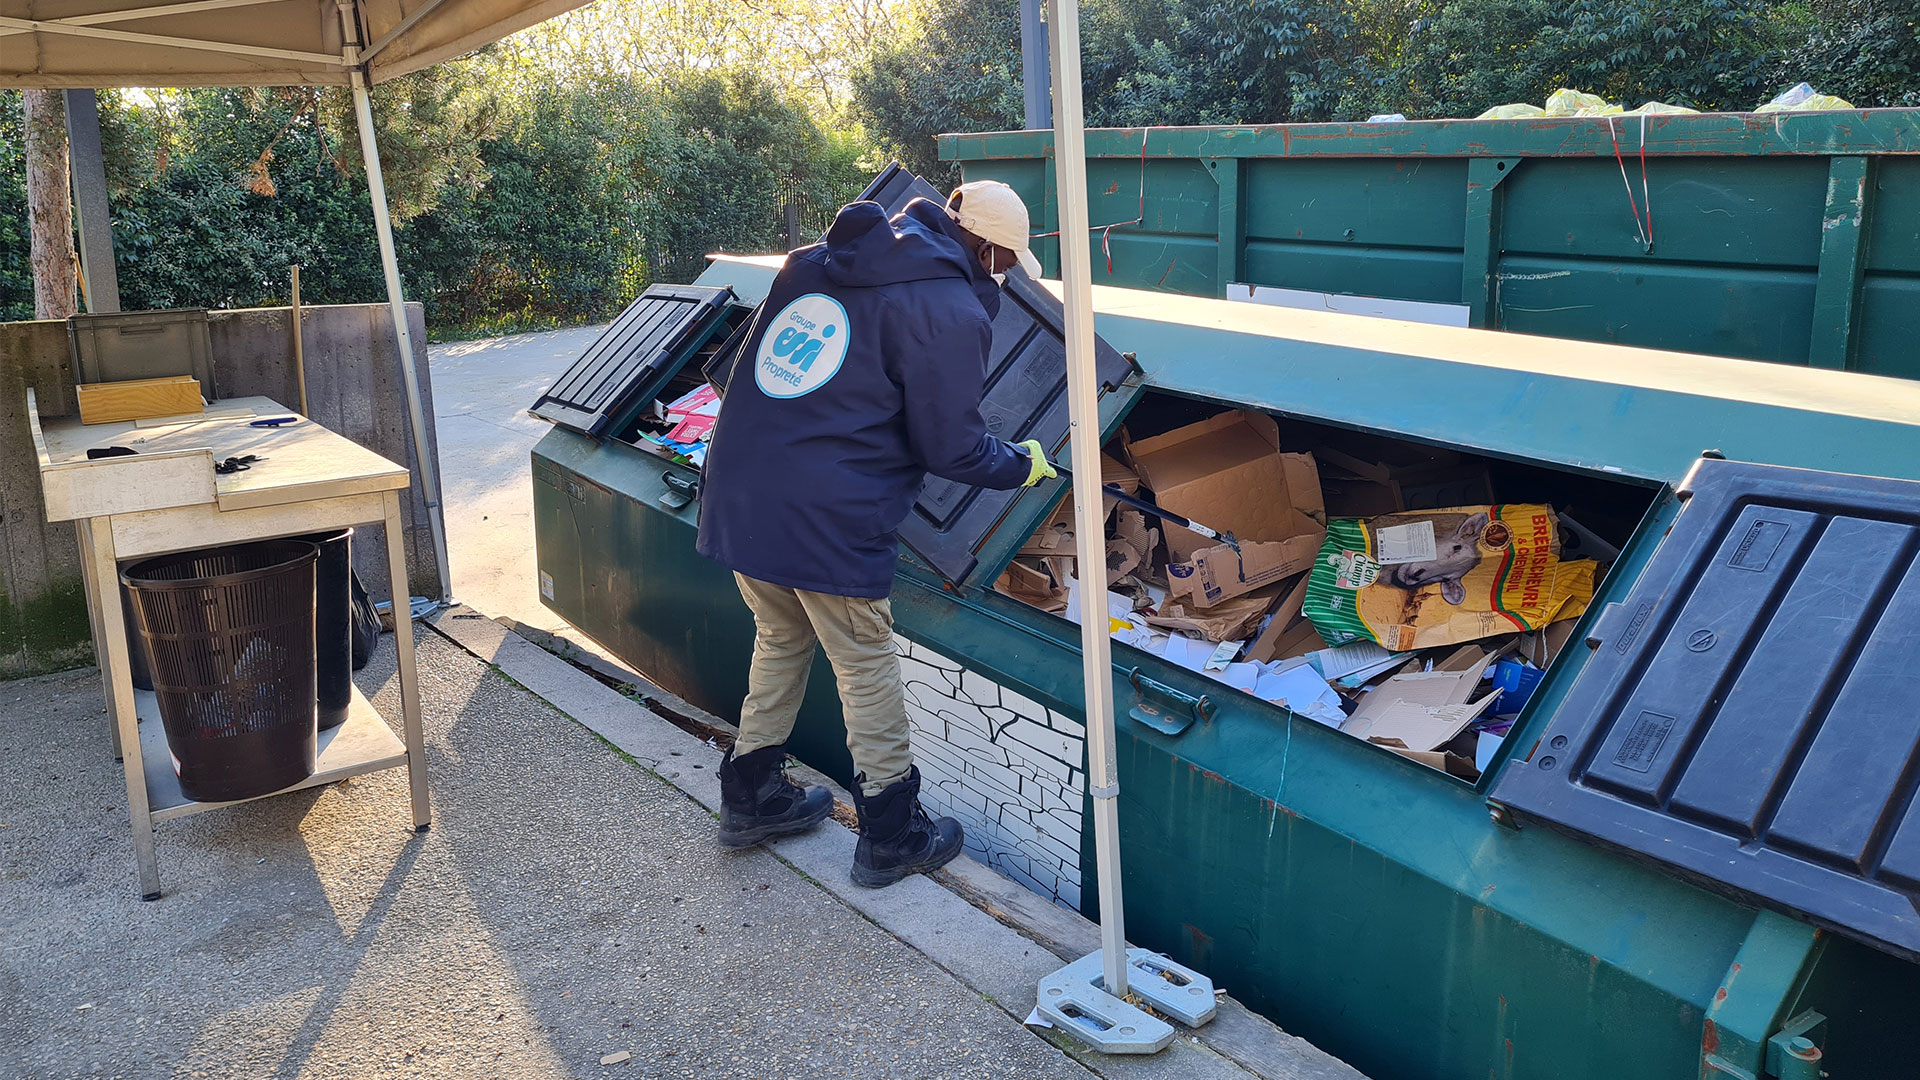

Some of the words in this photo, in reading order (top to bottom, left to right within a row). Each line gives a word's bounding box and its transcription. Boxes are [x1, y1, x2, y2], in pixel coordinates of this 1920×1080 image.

[789, 311, 816, 331] Groupe
[761, 356, 803, 387] Propreté
[1517, 537, 1527, 545] &
[1347, 553, 1367, 587] Champ
[1363, 560, 1382, 583] Plein
[1506, 547, 1529, 593] CHEVREUIL
